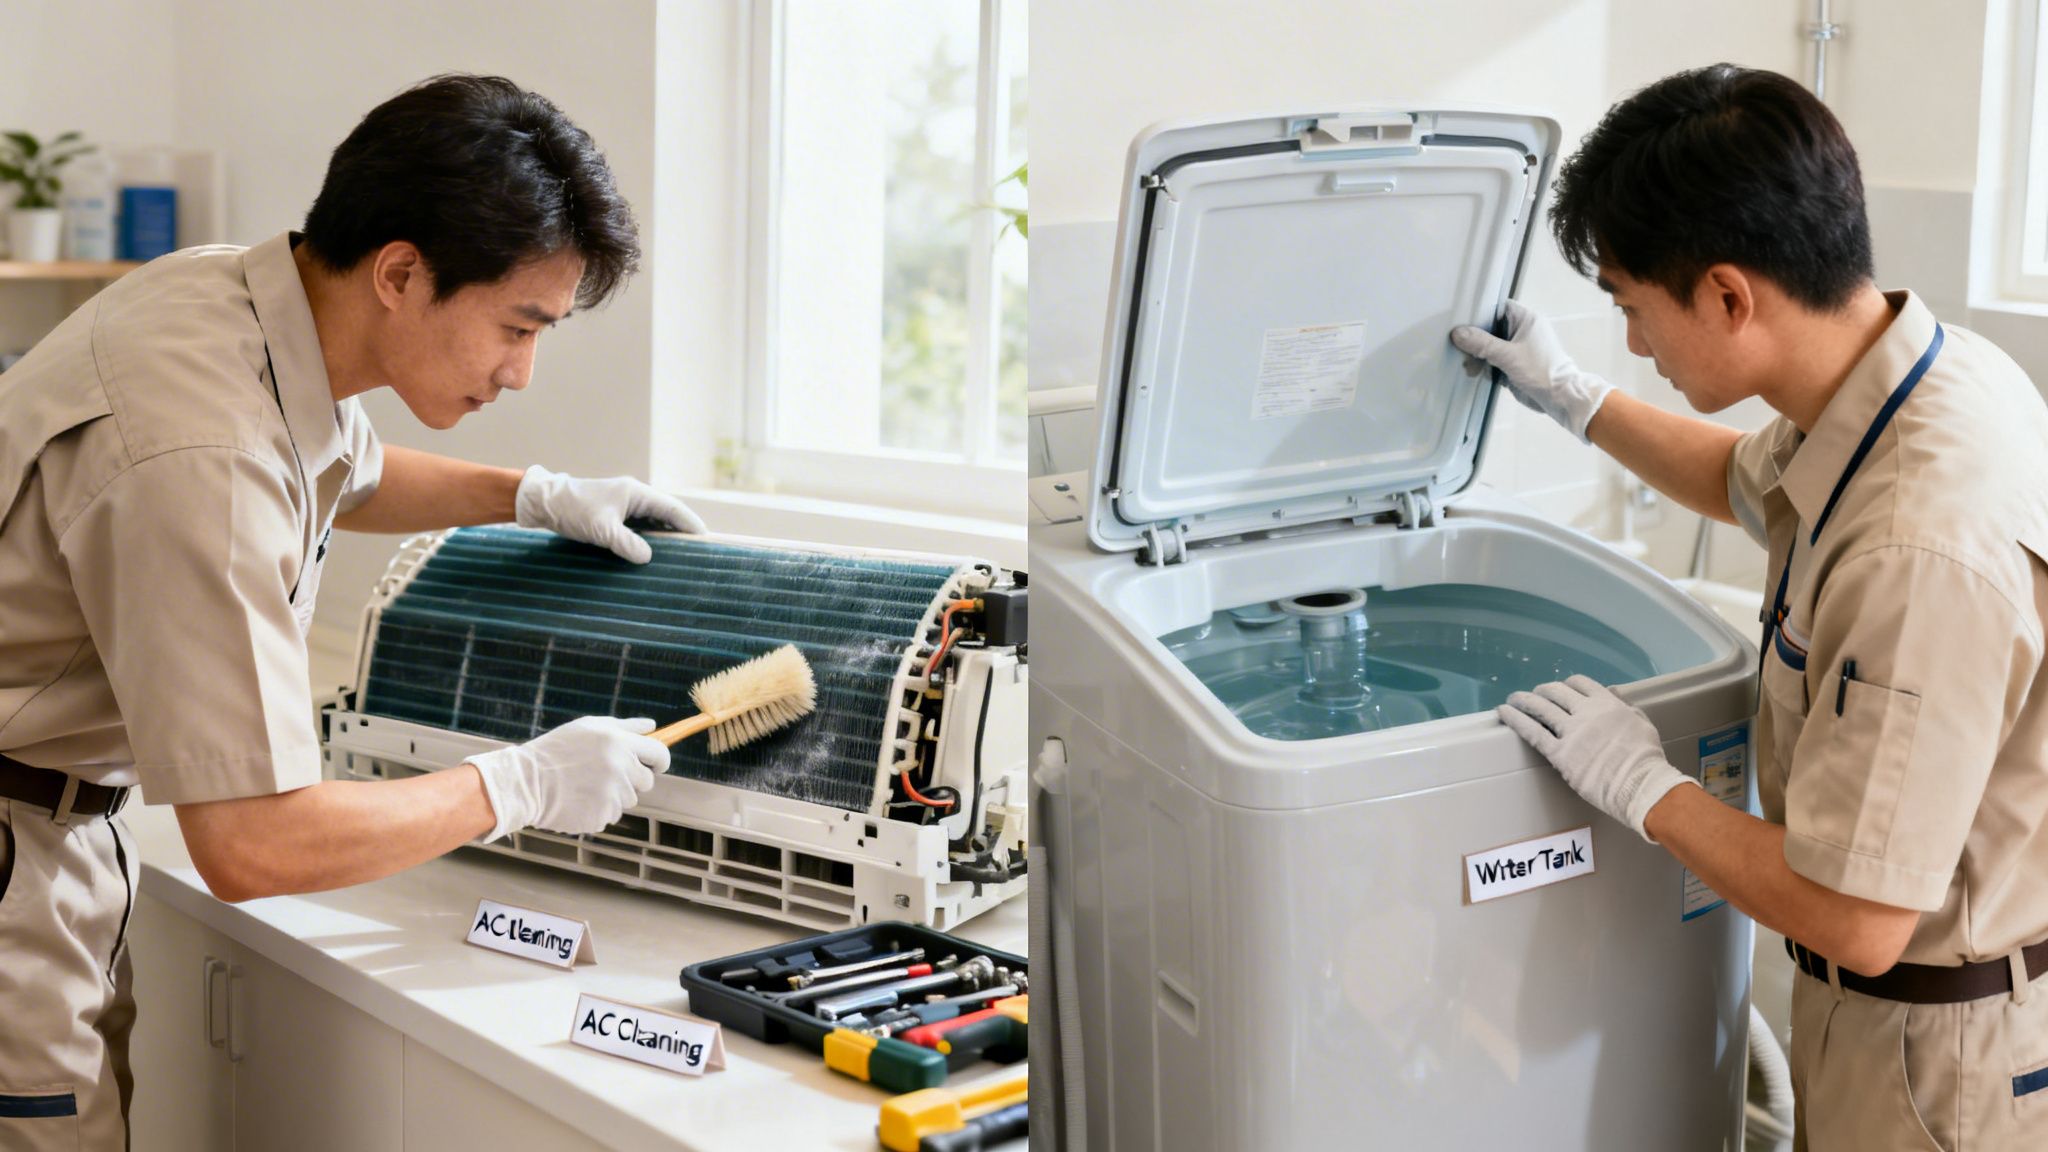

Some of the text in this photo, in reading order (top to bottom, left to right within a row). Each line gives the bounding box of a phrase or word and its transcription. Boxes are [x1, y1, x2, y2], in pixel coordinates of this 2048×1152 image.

[1538, 839, 1585, 871] Tank
[474, 911, 505, 937] AC
[580, 1008, 616, 1036] AC
